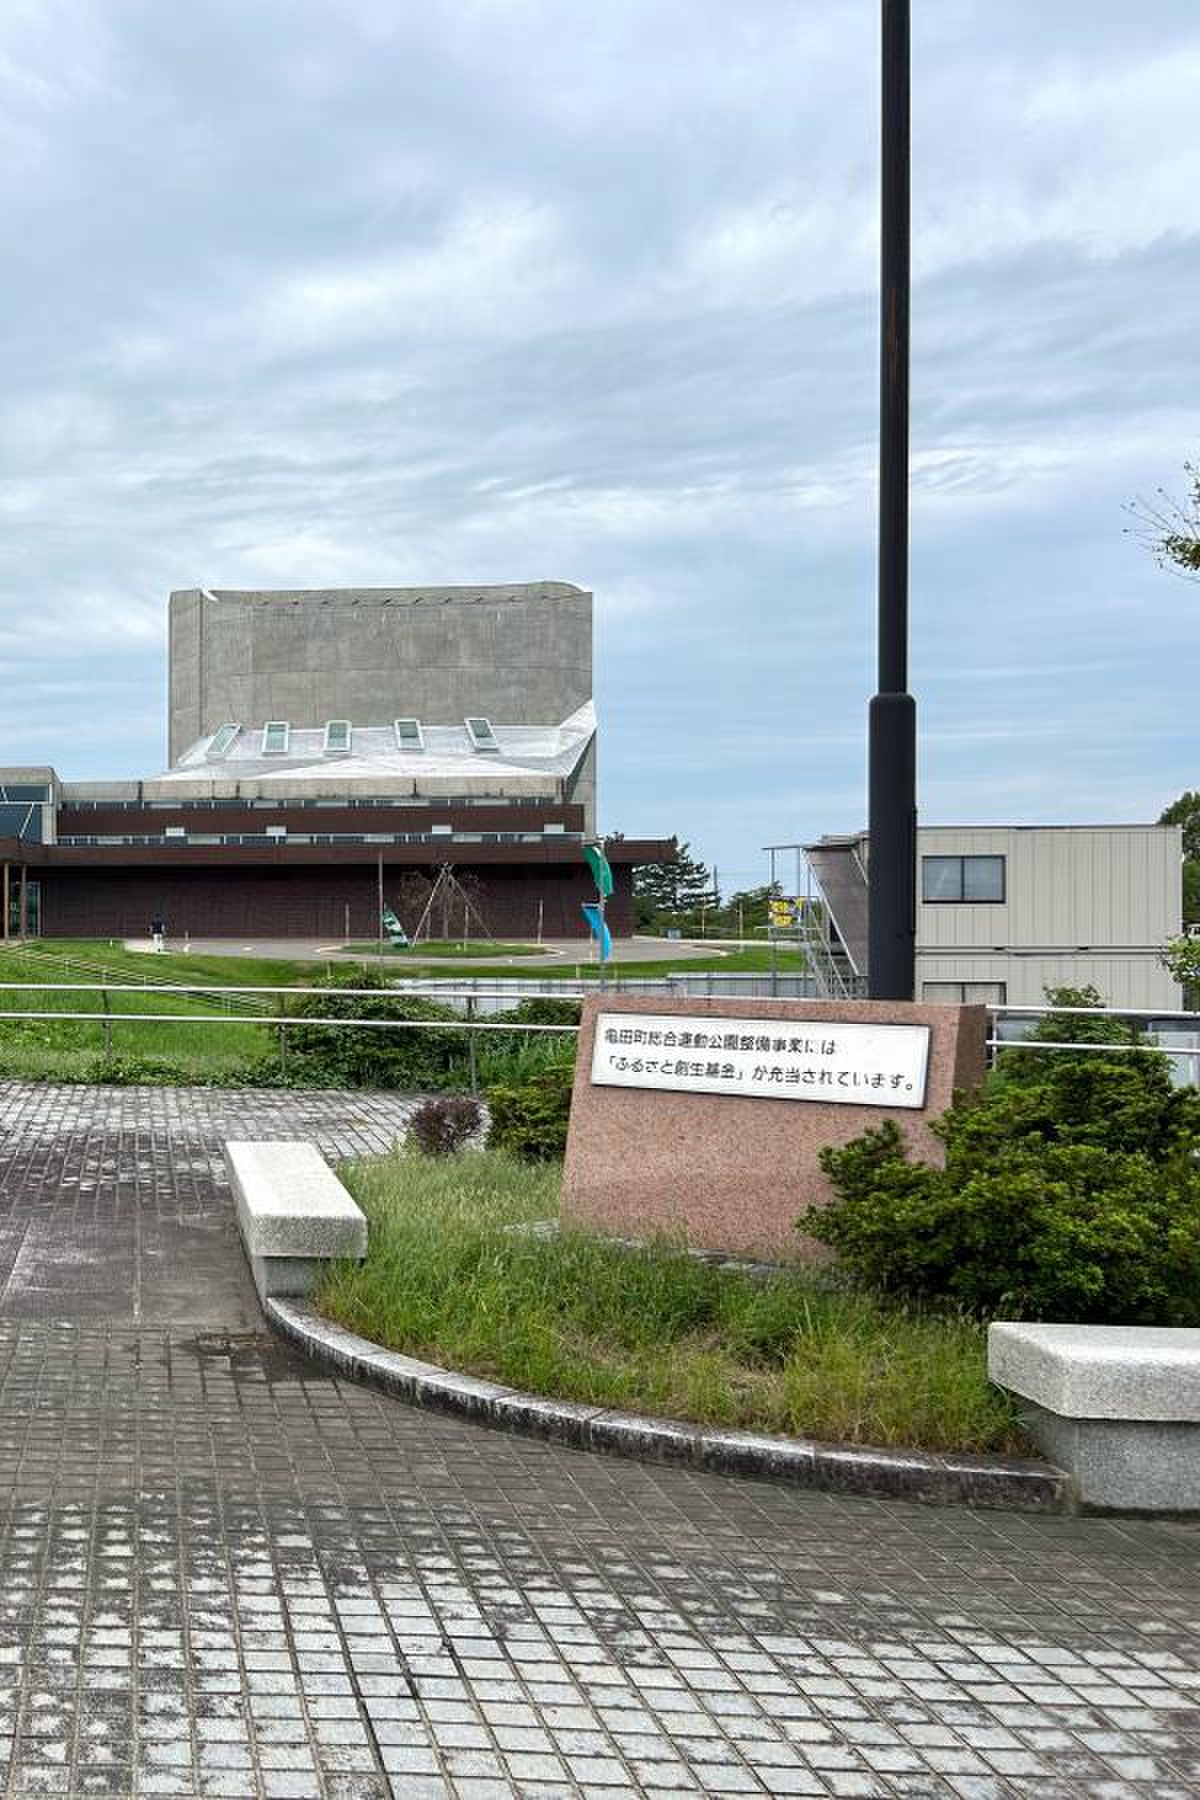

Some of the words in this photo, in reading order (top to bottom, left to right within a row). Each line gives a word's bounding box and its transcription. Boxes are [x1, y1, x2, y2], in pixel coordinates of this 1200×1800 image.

[604, 1027, 835, 1055] 亀田町総合運動公園整備事業には
